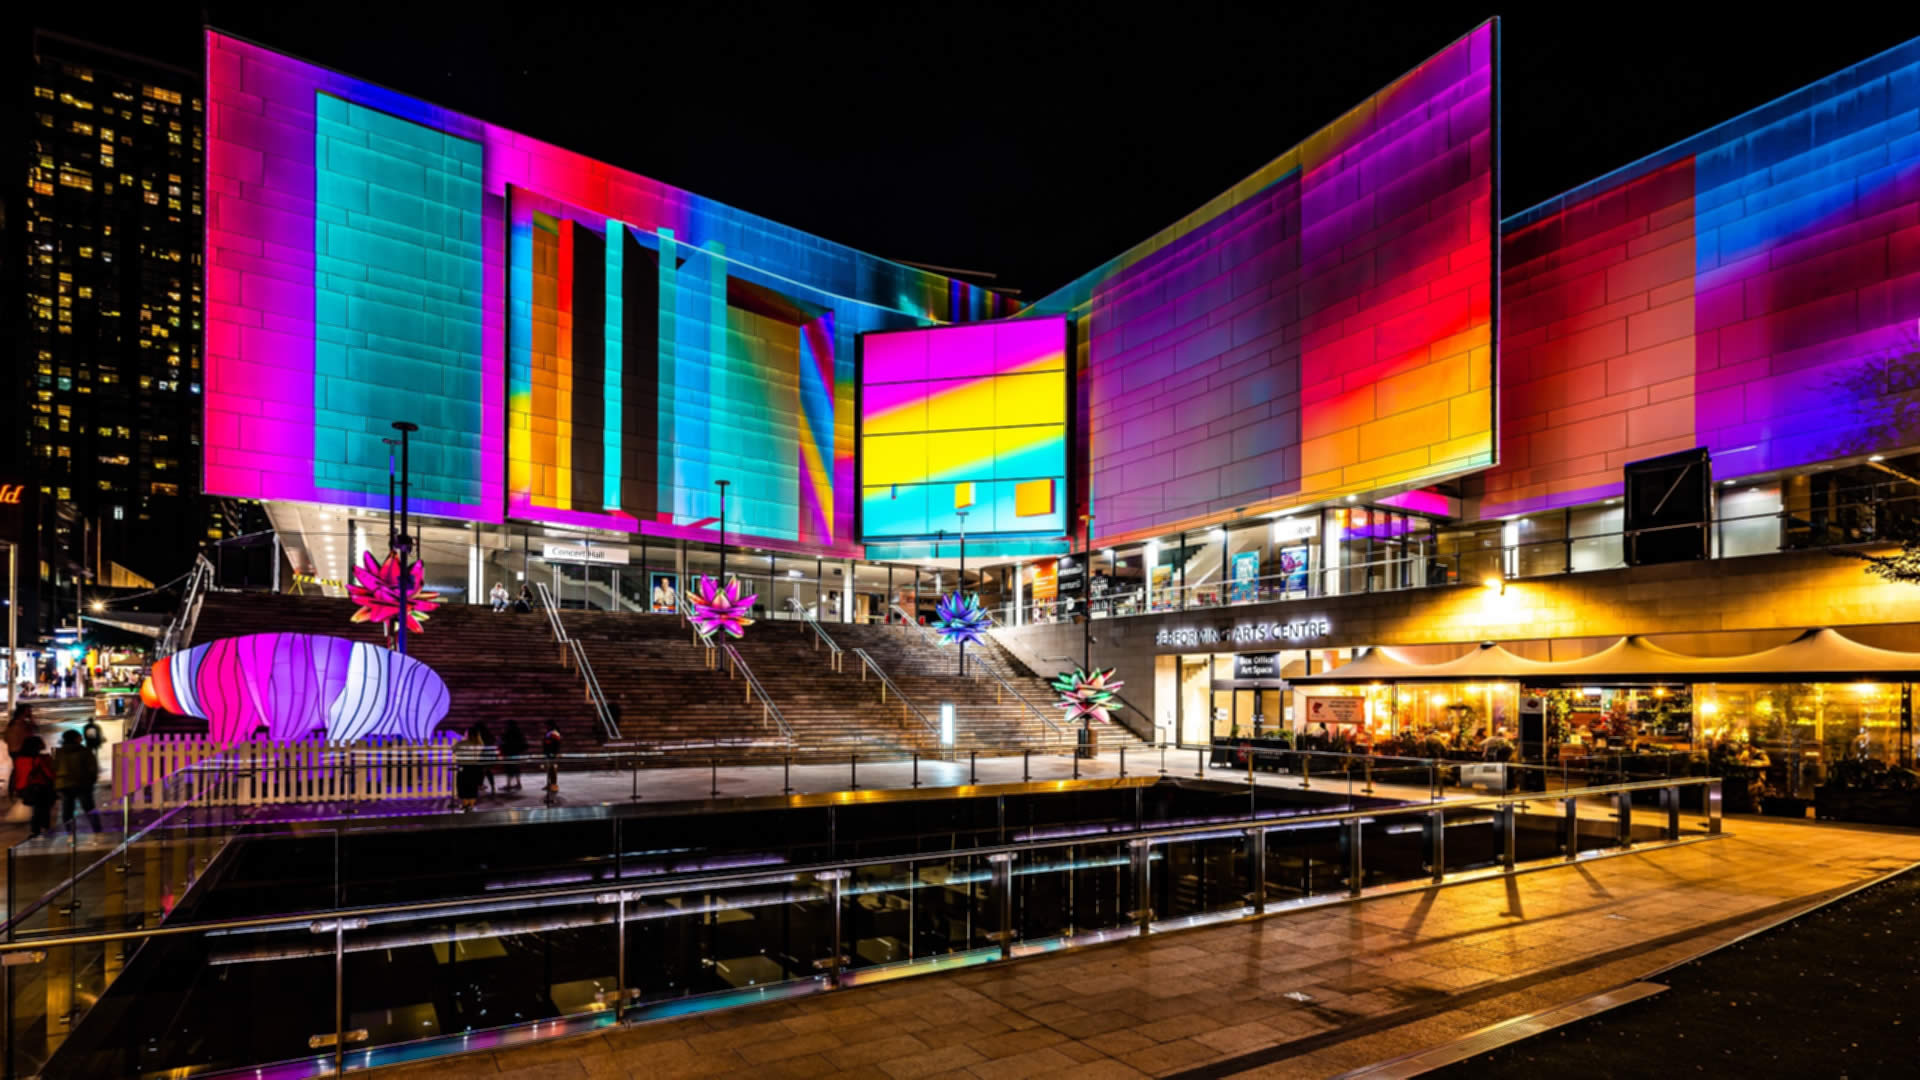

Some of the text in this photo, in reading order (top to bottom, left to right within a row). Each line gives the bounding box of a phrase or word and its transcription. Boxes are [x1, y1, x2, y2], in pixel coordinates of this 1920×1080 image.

[1234, 624, 1266, 642] ARTS
[1271, 621, 1327, 640] CENTRE
[1253, 655, 1274, 665] Office
[1240, 665, 1274, 676] Art Space
